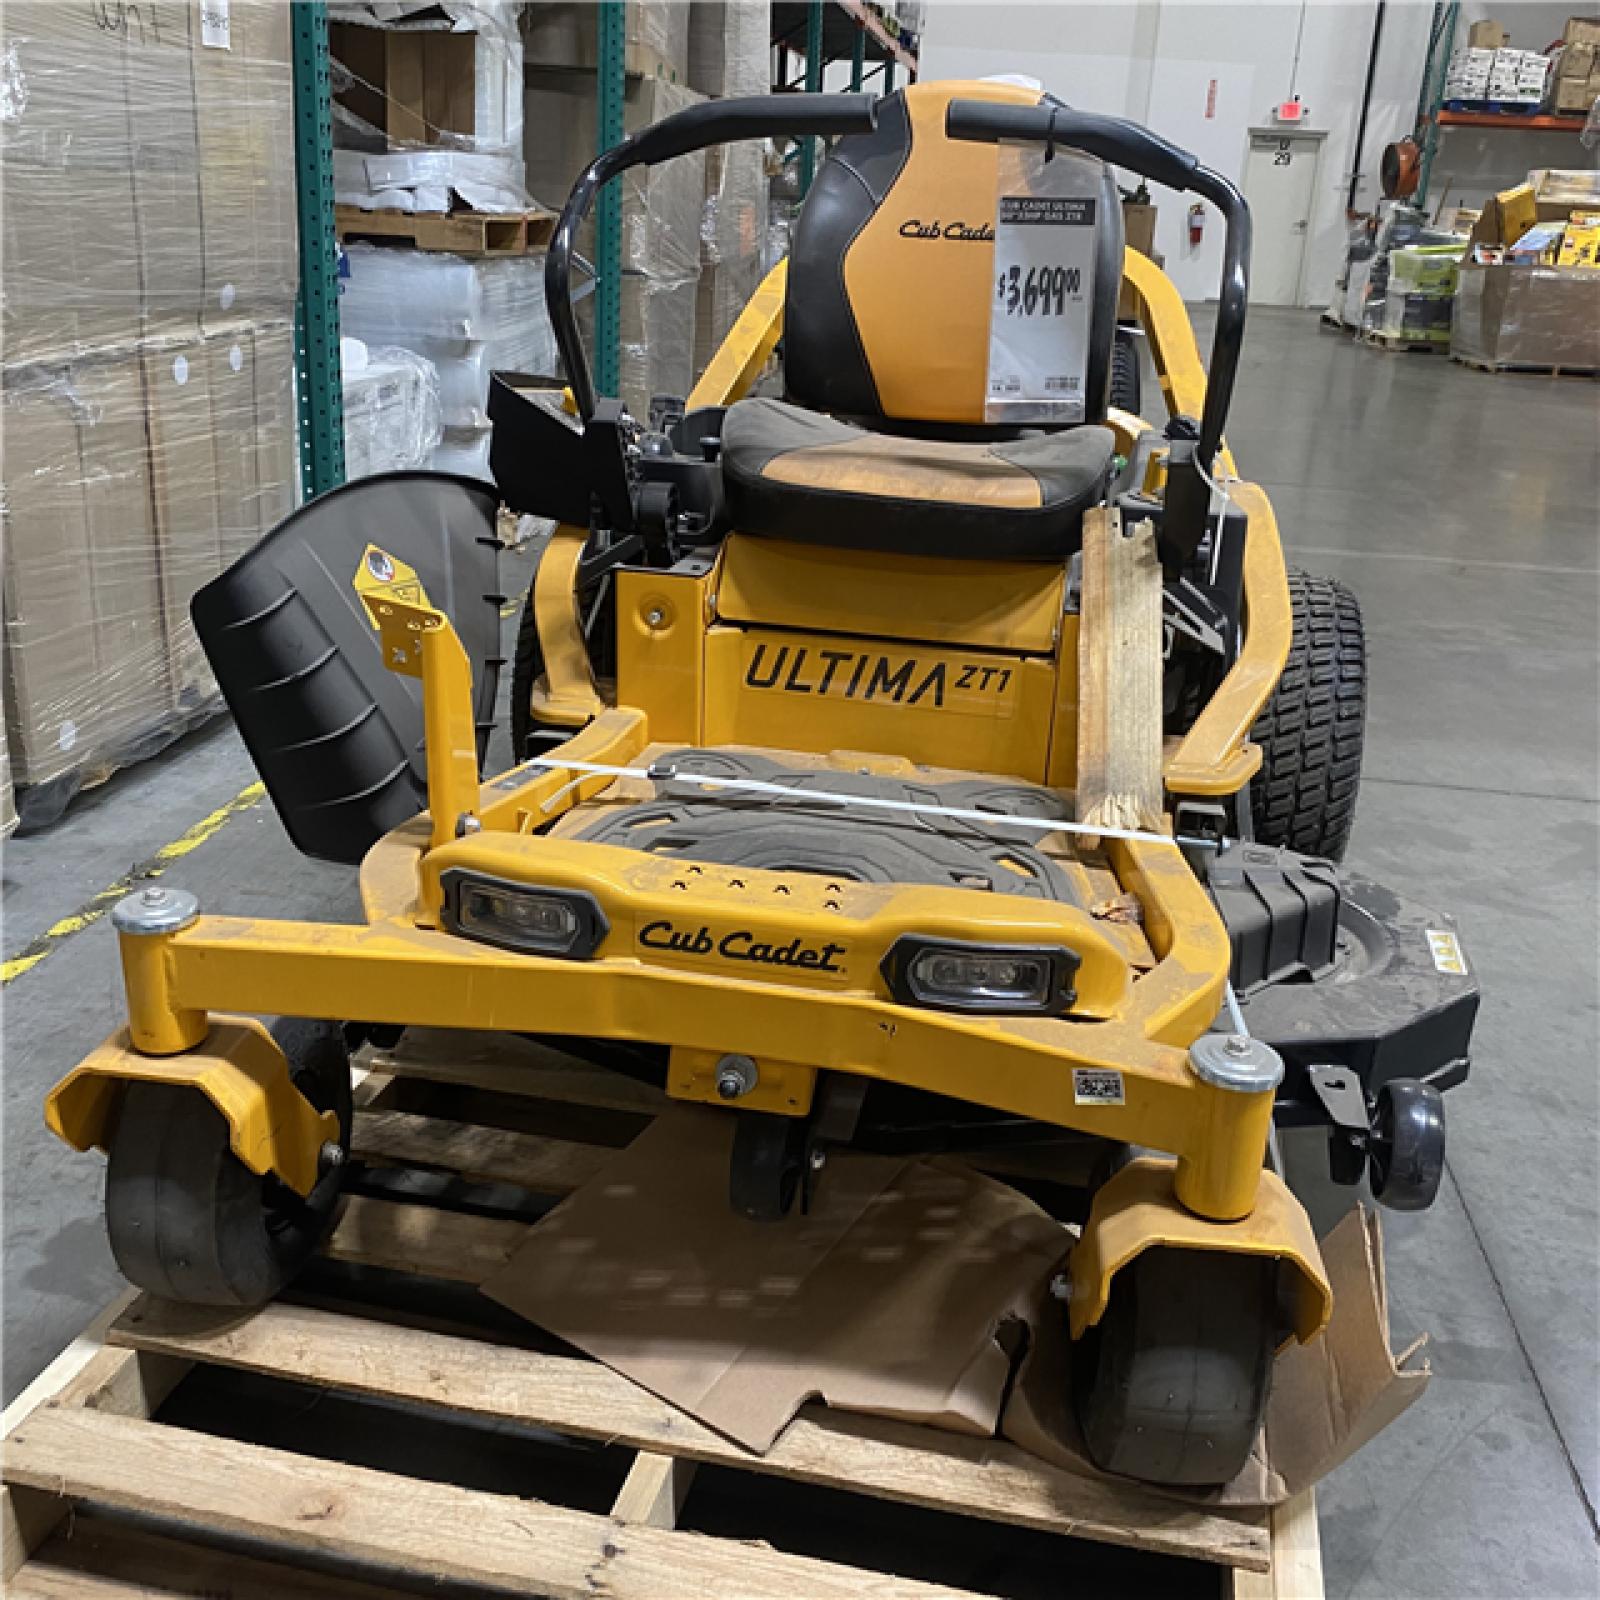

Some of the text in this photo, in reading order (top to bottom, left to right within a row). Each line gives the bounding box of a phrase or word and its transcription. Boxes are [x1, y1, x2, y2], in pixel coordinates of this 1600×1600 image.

[1275, 152, 1290, 165] 29
[899, 220, 995, 240] Cub Cade
[746, 643, 1013, 707] ULTIMA ZT1
[639, 920, 847, 972] Cub Cadet
